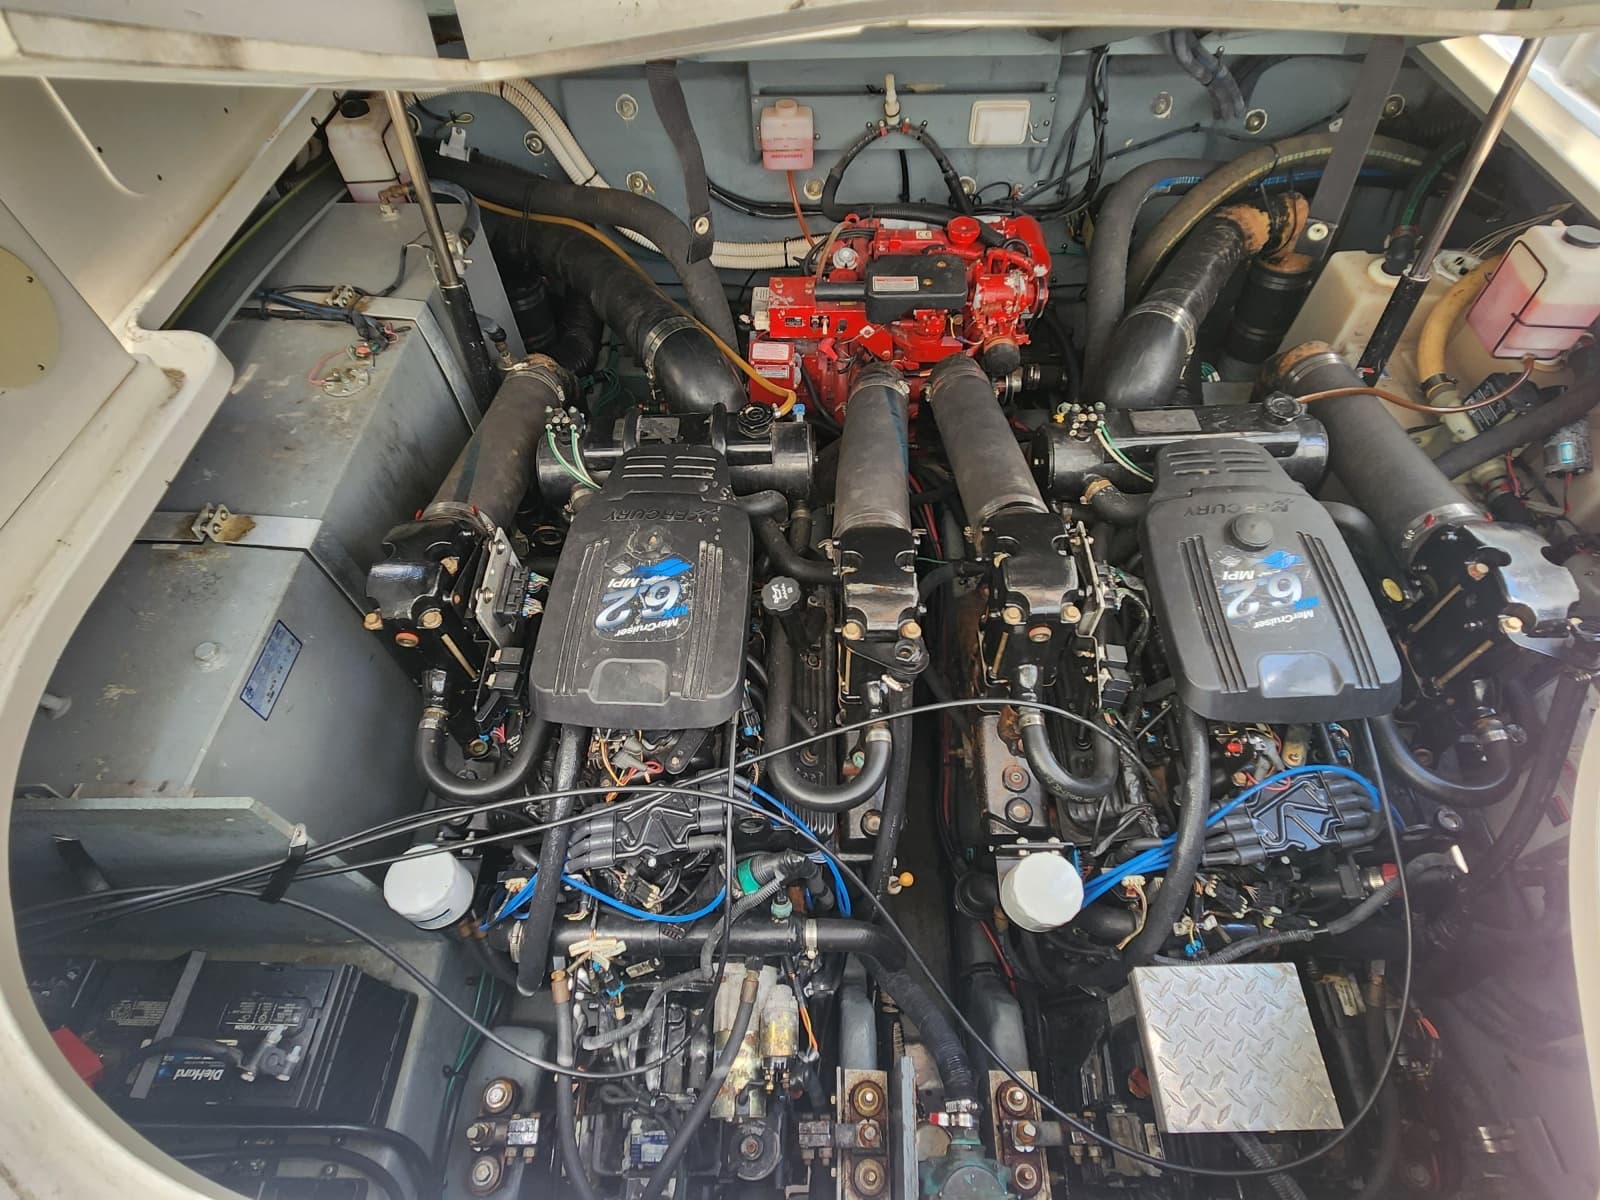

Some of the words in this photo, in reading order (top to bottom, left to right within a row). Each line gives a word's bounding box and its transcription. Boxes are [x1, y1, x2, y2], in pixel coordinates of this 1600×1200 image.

[1183, 498, 1294, 516] MERCURY
[609, 577, 640, 588] MPI
[1222, 571, 1255, 580] MPI
[614, 617, 679, 637] MerCruiser
[1254, 611, 1315, 629] MerCruiser
[172, 1069, 225, 1081] DieHard
